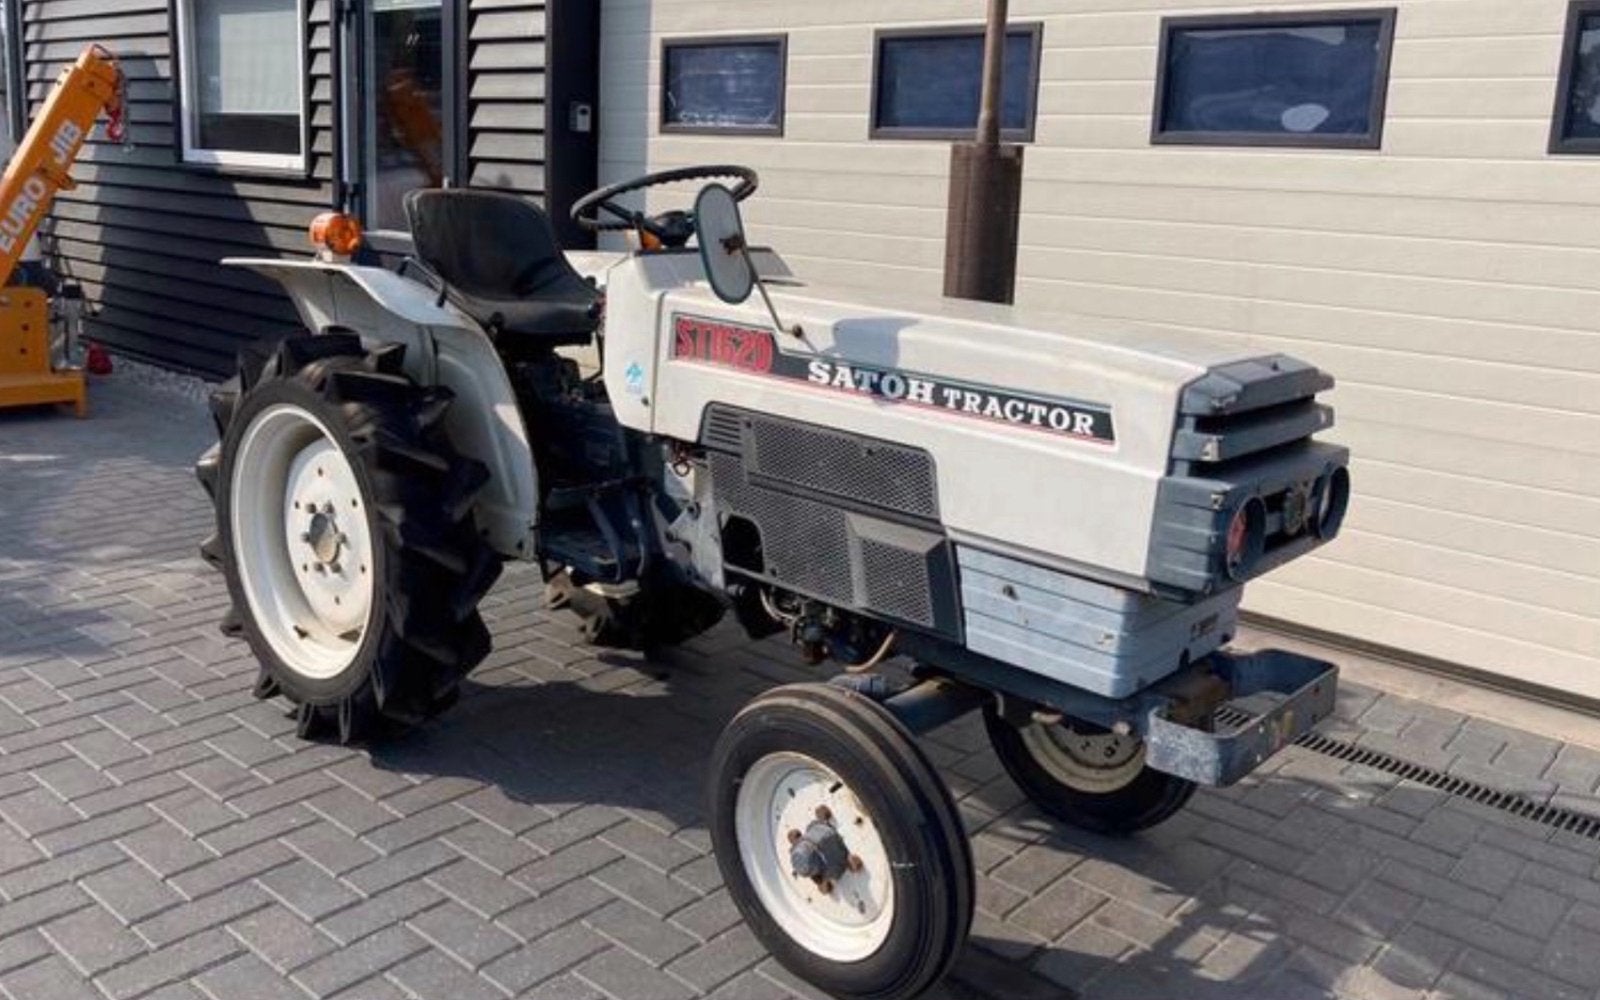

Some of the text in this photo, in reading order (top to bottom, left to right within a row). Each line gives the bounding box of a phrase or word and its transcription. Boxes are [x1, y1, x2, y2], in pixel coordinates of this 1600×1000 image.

[0, 119, 82, 253] EURO JIB
[808, 361, 1094, 435] SATOH TRACTOR
